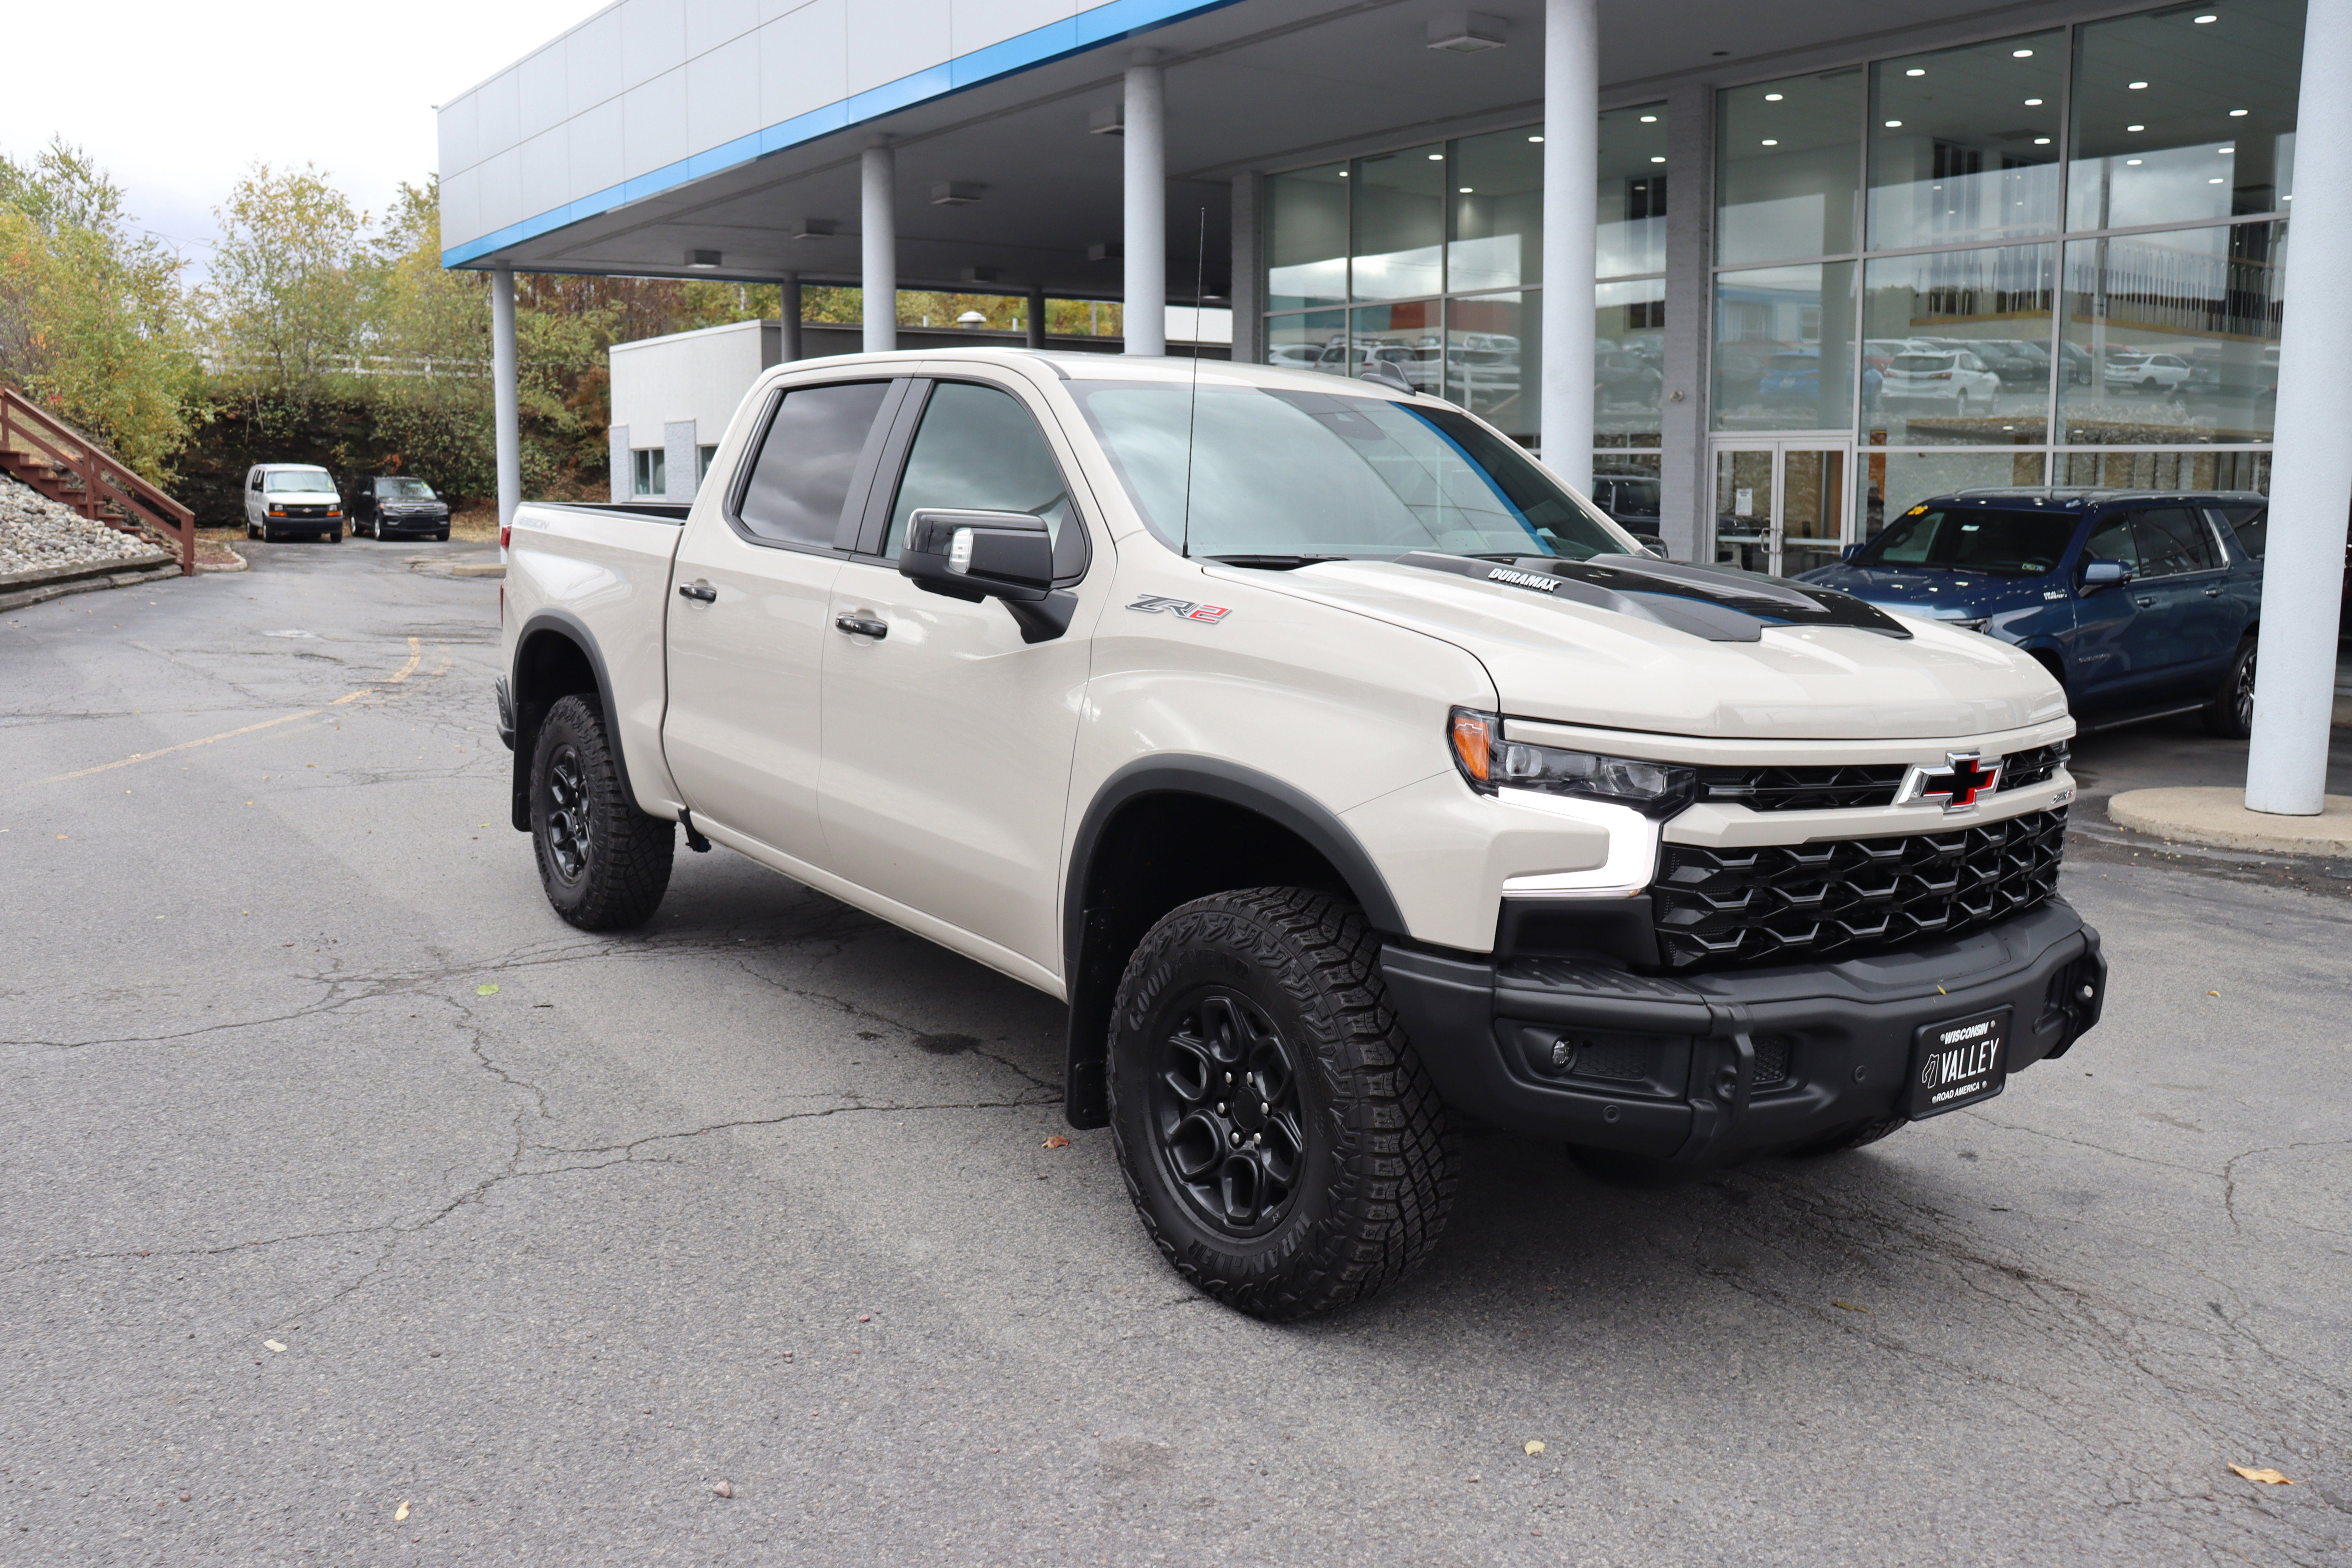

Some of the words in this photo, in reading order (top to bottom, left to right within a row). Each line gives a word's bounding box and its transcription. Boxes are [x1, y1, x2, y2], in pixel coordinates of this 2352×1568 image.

[1488, 568, 1561, 592] DURAMAX
[1125, 592, 1233, 625] ZR2
[1129, 948, 1250, 1031] GOODYEAR
[1944, 1021, 1989, 1045] WISCONSIN
[1941, 1038, 1999, 1085] VALLEY
[1936, 1089, 1955, 1102] ROAD
[1954, 1081, 1980, 1098] AMERICA
[1187, 1209, 1312, 1277] WRANGLER
